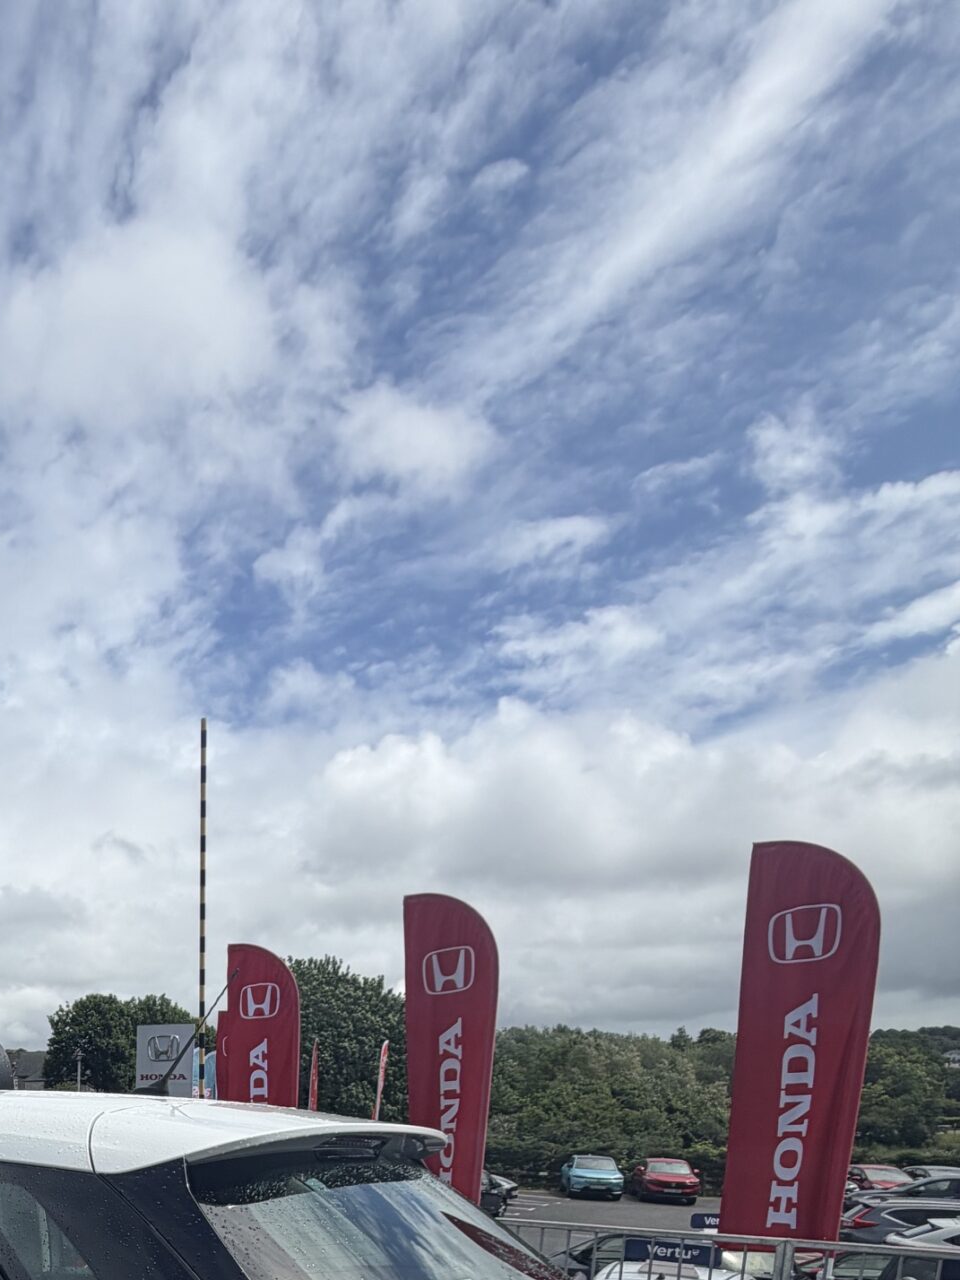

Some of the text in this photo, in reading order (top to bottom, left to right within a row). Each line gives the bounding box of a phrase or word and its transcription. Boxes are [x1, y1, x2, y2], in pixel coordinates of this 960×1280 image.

[249, 1038, 269, 1104] DA
[766, 993, 819, 1229] HONDA
[647, 1244, 692, 1259] Vertu
